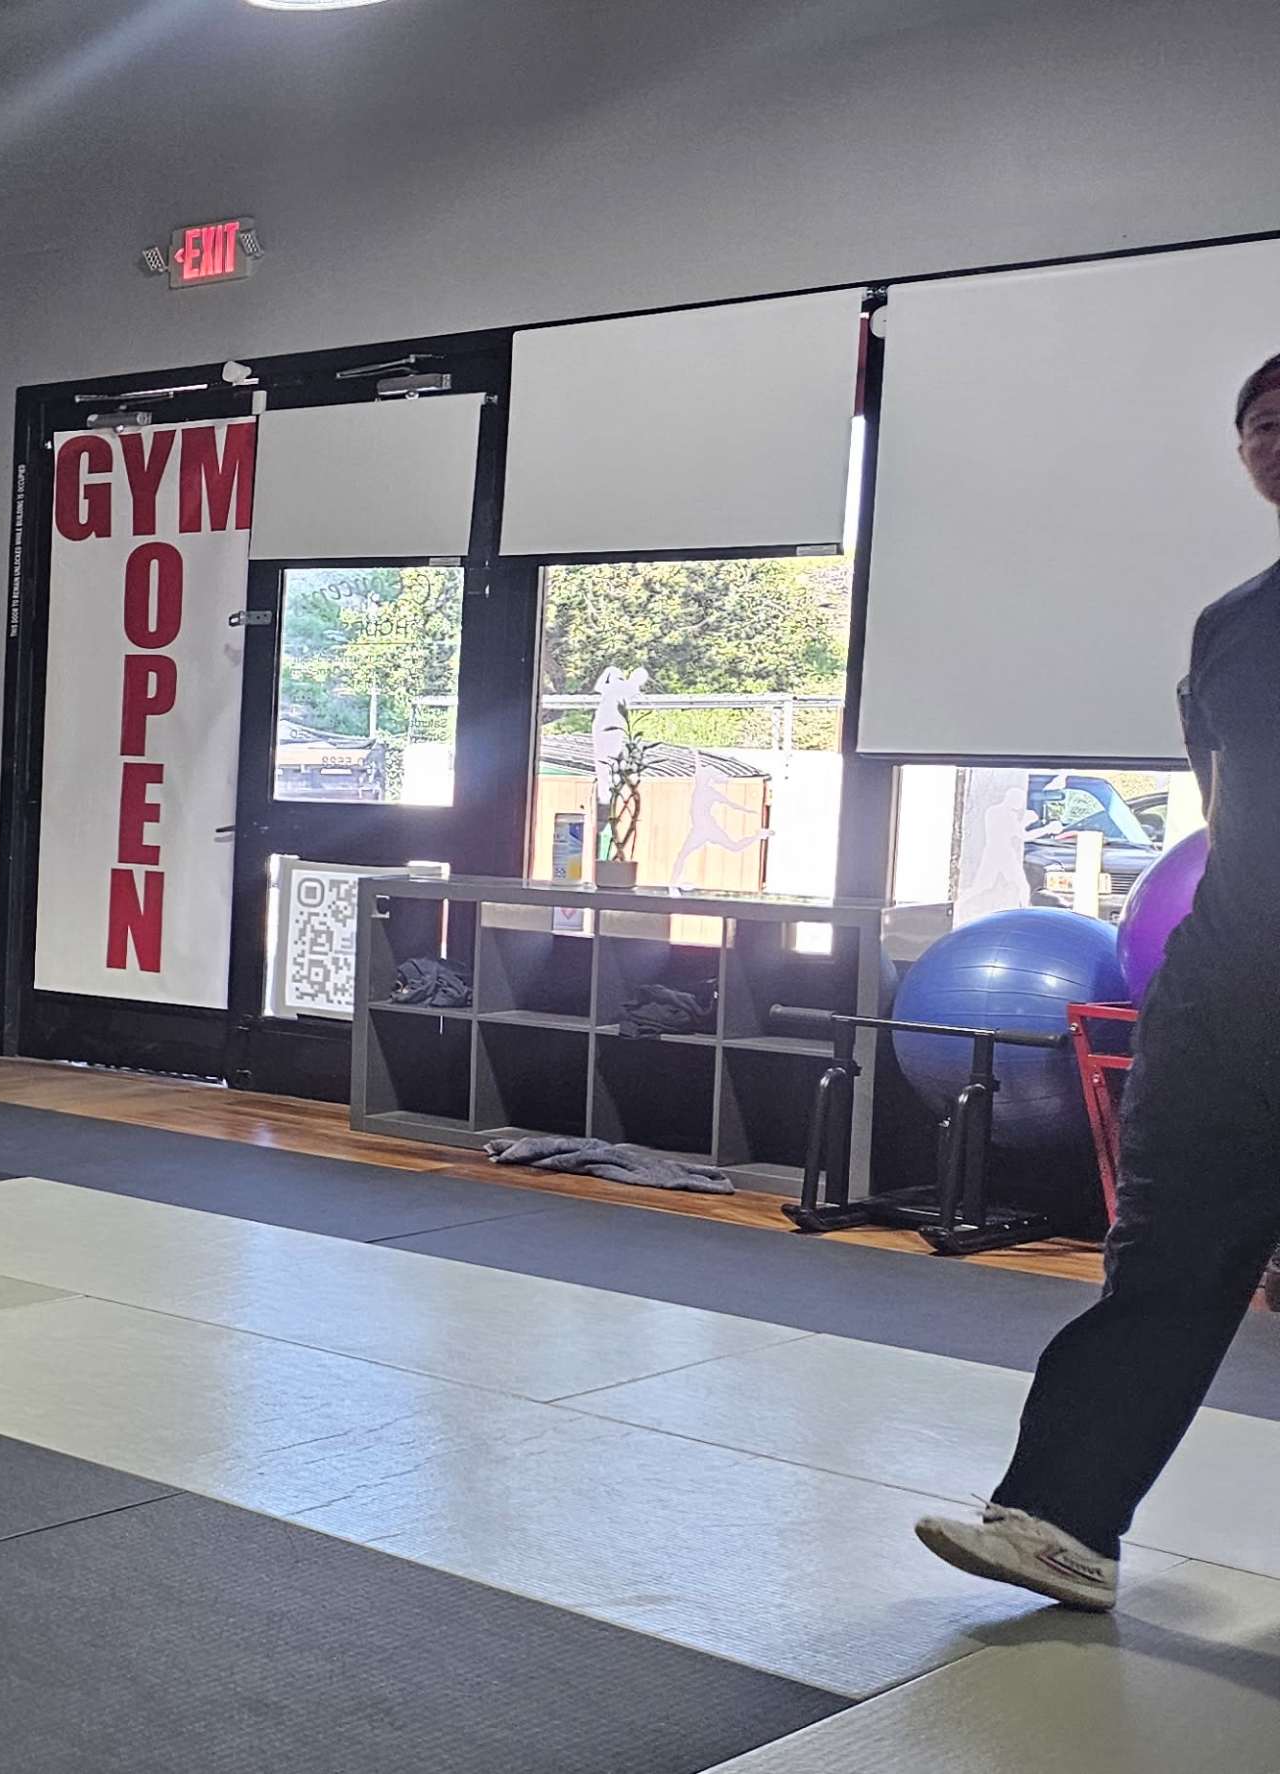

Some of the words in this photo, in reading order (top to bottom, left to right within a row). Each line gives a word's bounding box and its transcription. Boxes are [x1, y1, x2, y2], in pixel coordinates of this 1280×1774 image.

[183, 221, 240, 279] EXIT
[17, 464, 26, 492] OCCUPIED
[55, 422, 257, 541] GYM
[16, 500, 24, 527] BUILDING
[106, 542, 183, 973] OPEN
